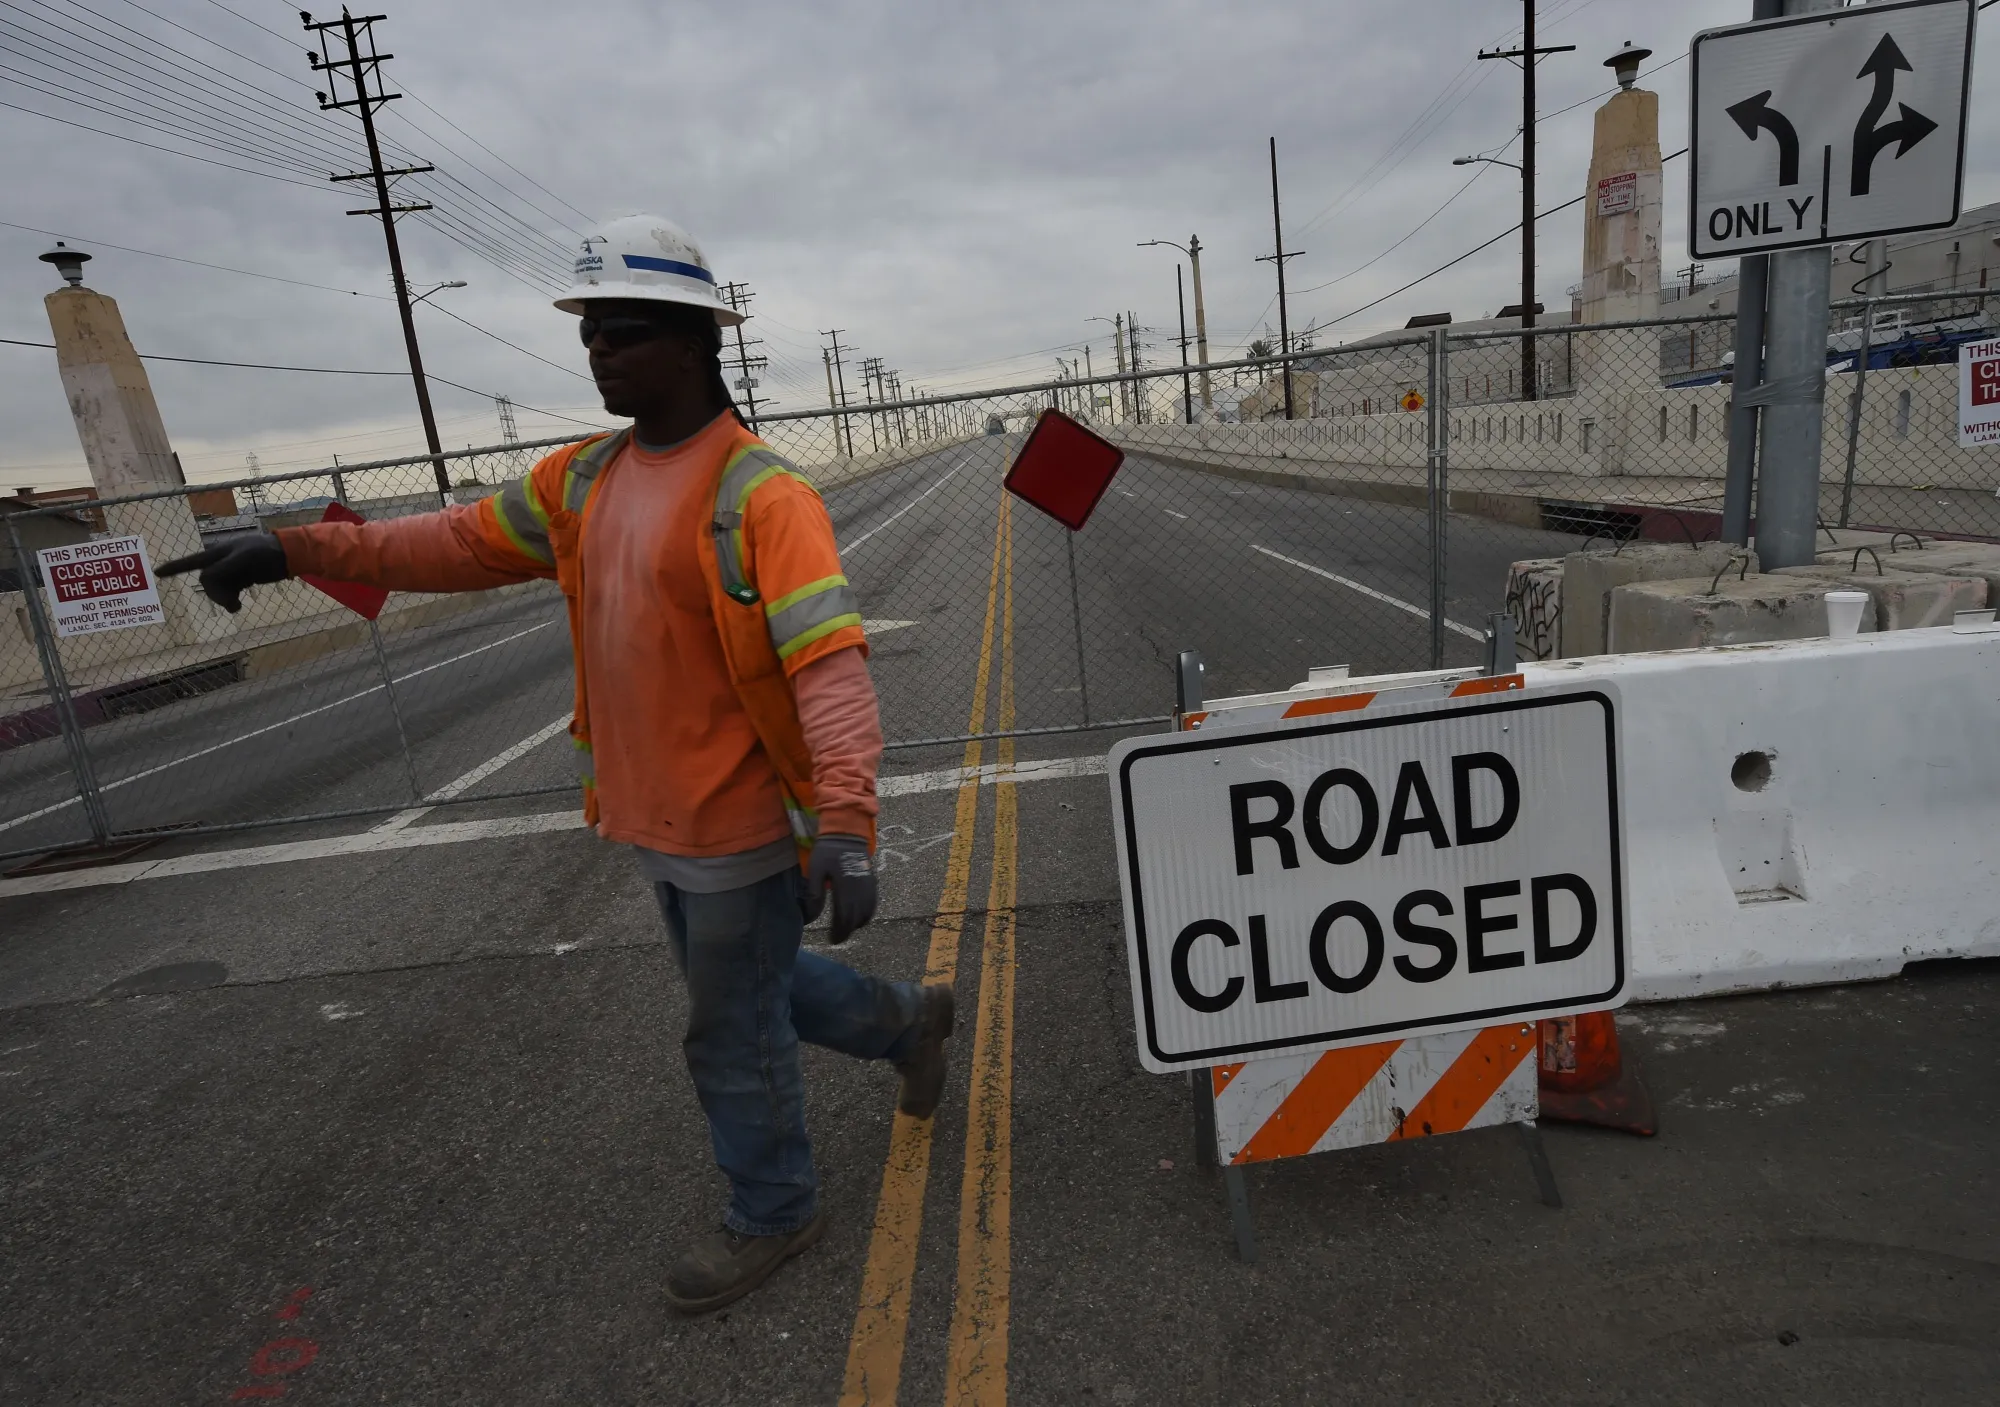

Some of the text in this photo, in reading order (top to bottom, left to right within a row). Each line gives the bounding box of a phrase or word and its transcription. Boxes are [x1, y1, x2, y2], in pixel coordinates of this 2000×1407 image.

[1599, 181, 1635, 198] NO STOPPING
[1600, 174, 1635, 186] TOW-AWAY
[1602, 192, 1631, 205] ANY TIME
[1709, 195, 1814, 241] ONLY
[42, 539, 139, 563] THIS PROPERTY
[57, 556, 135, 581] CLOSED TO
[60, 573, 141, 598] THE PUBLIC
[58, 604, 160, 626] WITHOUT PERMISSION
[81, 597, 129, 612] NO ENTRY
[127, 617, 137, 625] PC
[1229, 751, 1521, 877] ROAD
[1170, 872, 1598, 1014] CLOSED
